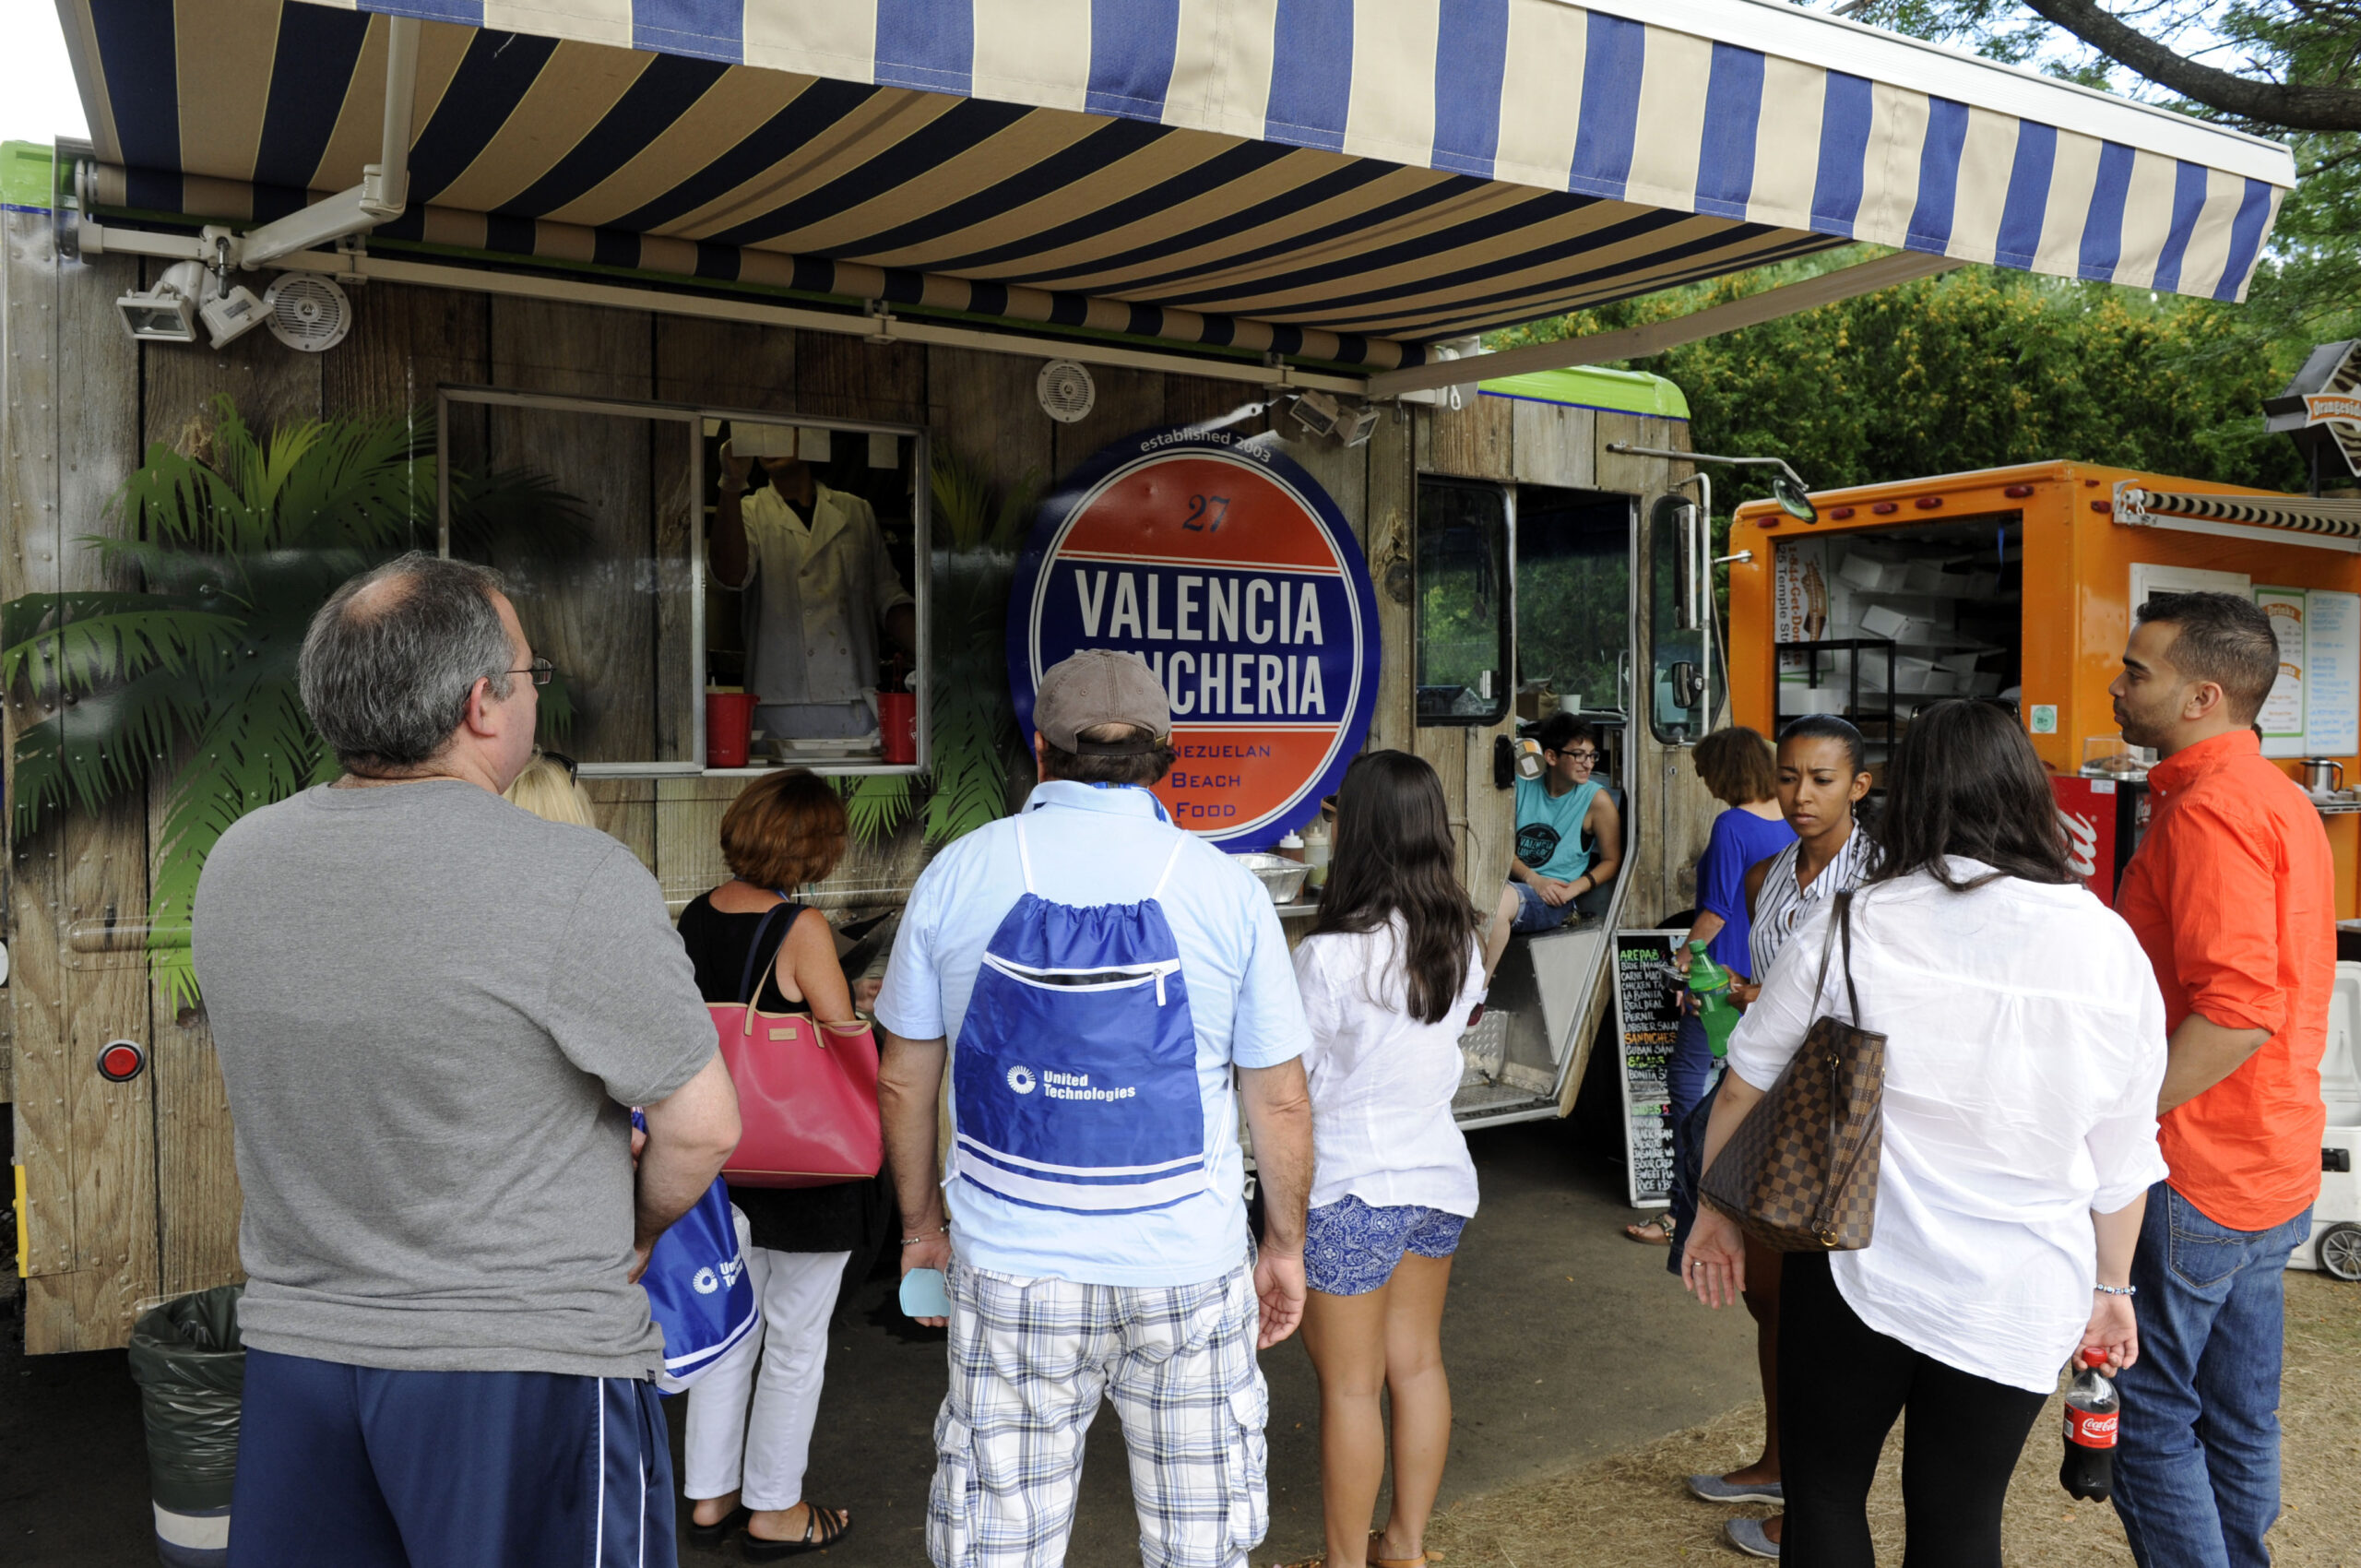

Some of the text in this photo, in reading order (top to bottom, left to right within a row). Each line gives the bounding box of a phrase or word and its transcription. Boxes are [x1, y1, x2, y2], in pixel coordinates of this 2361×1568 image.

[1140, 428, 1271, 463] established 2003
[1182, 493, 1230, 533] 27
[1074, 569, 1323, 645] VALENCIA
[1777, 546, 1791, 667] 25 Temple Stret
[1788, 546, 1802, 666] 1-844-Get-Donts
[1074, 648, 1326, 715] CHERIA
[1172, 745, 1271, 758] NEZUELAN
[1619, 948, 1659, 961] AREPAS
[1623, 1012, 1655, 1022] PERNIL
[1623, 1022, 1656, 1032] LOBSTER
[1626, 1045, 1653, 1055] CUBAN
[1043, 1070, 1088, 1087] United
[1629, 1069, 1657, 1081] BONITA
[1043, 1084, 1135, 1102] Technologies
